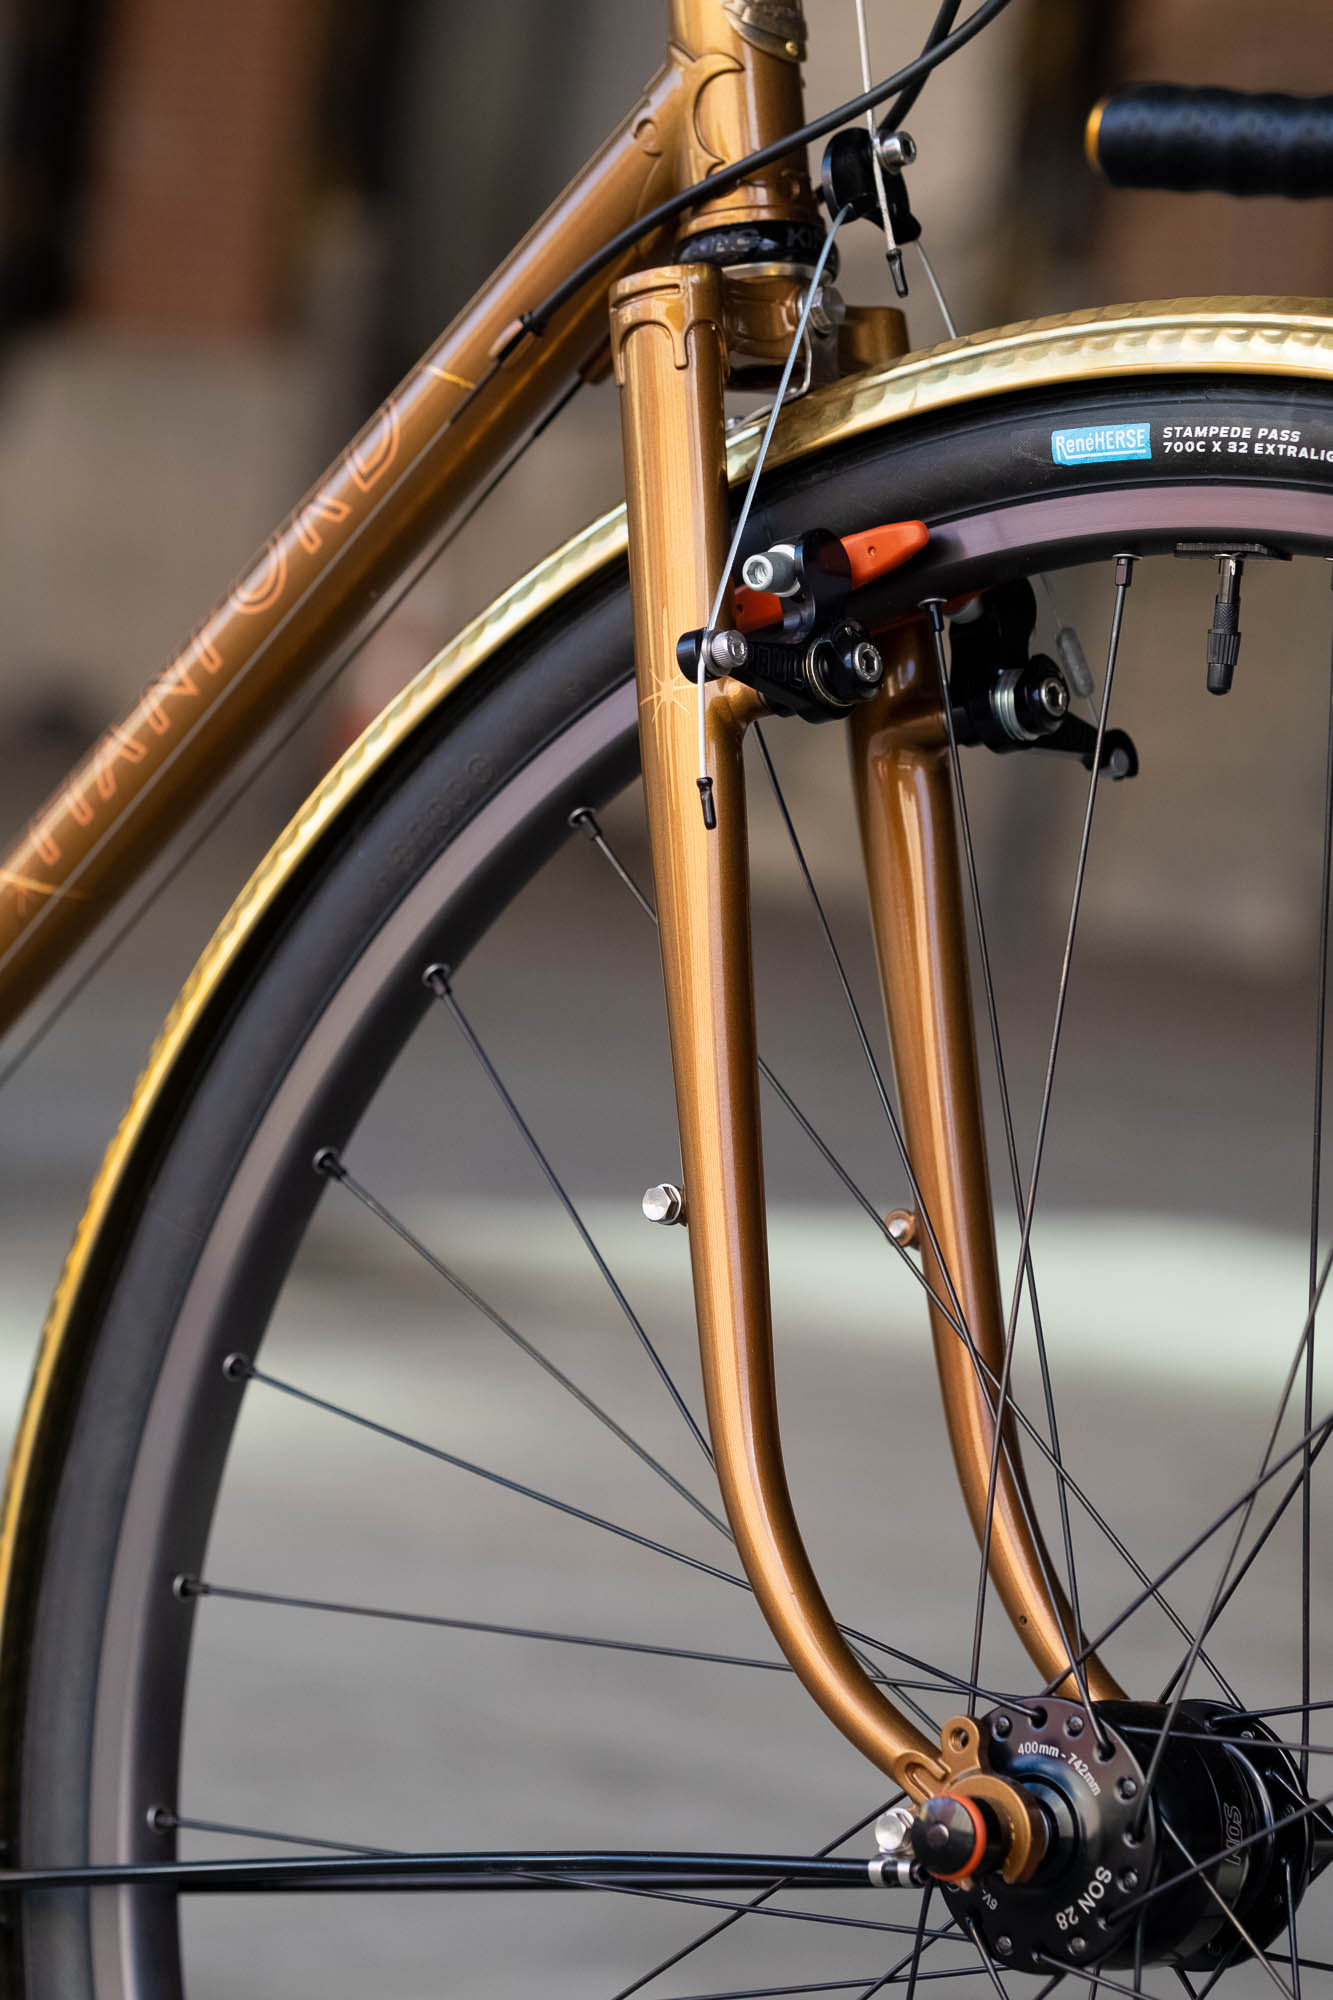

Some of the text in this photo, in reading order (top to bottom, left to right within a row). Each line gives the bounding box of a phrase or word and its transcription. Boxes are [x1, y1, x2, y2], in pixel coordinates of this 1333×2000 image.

[1163, 426, 1301, 442] STAMPEDE PASS
[1163, 441, 1206, 453] 700C
[1211, 441, 1222, 452] X
[1228, 442, 1248, 454] 32
[1018, 1741, 1060, 1758] 400mm
[1067, 1752, 1101, 1797] 742mm
[1056, 1866, 1112, 1930] SON 28
